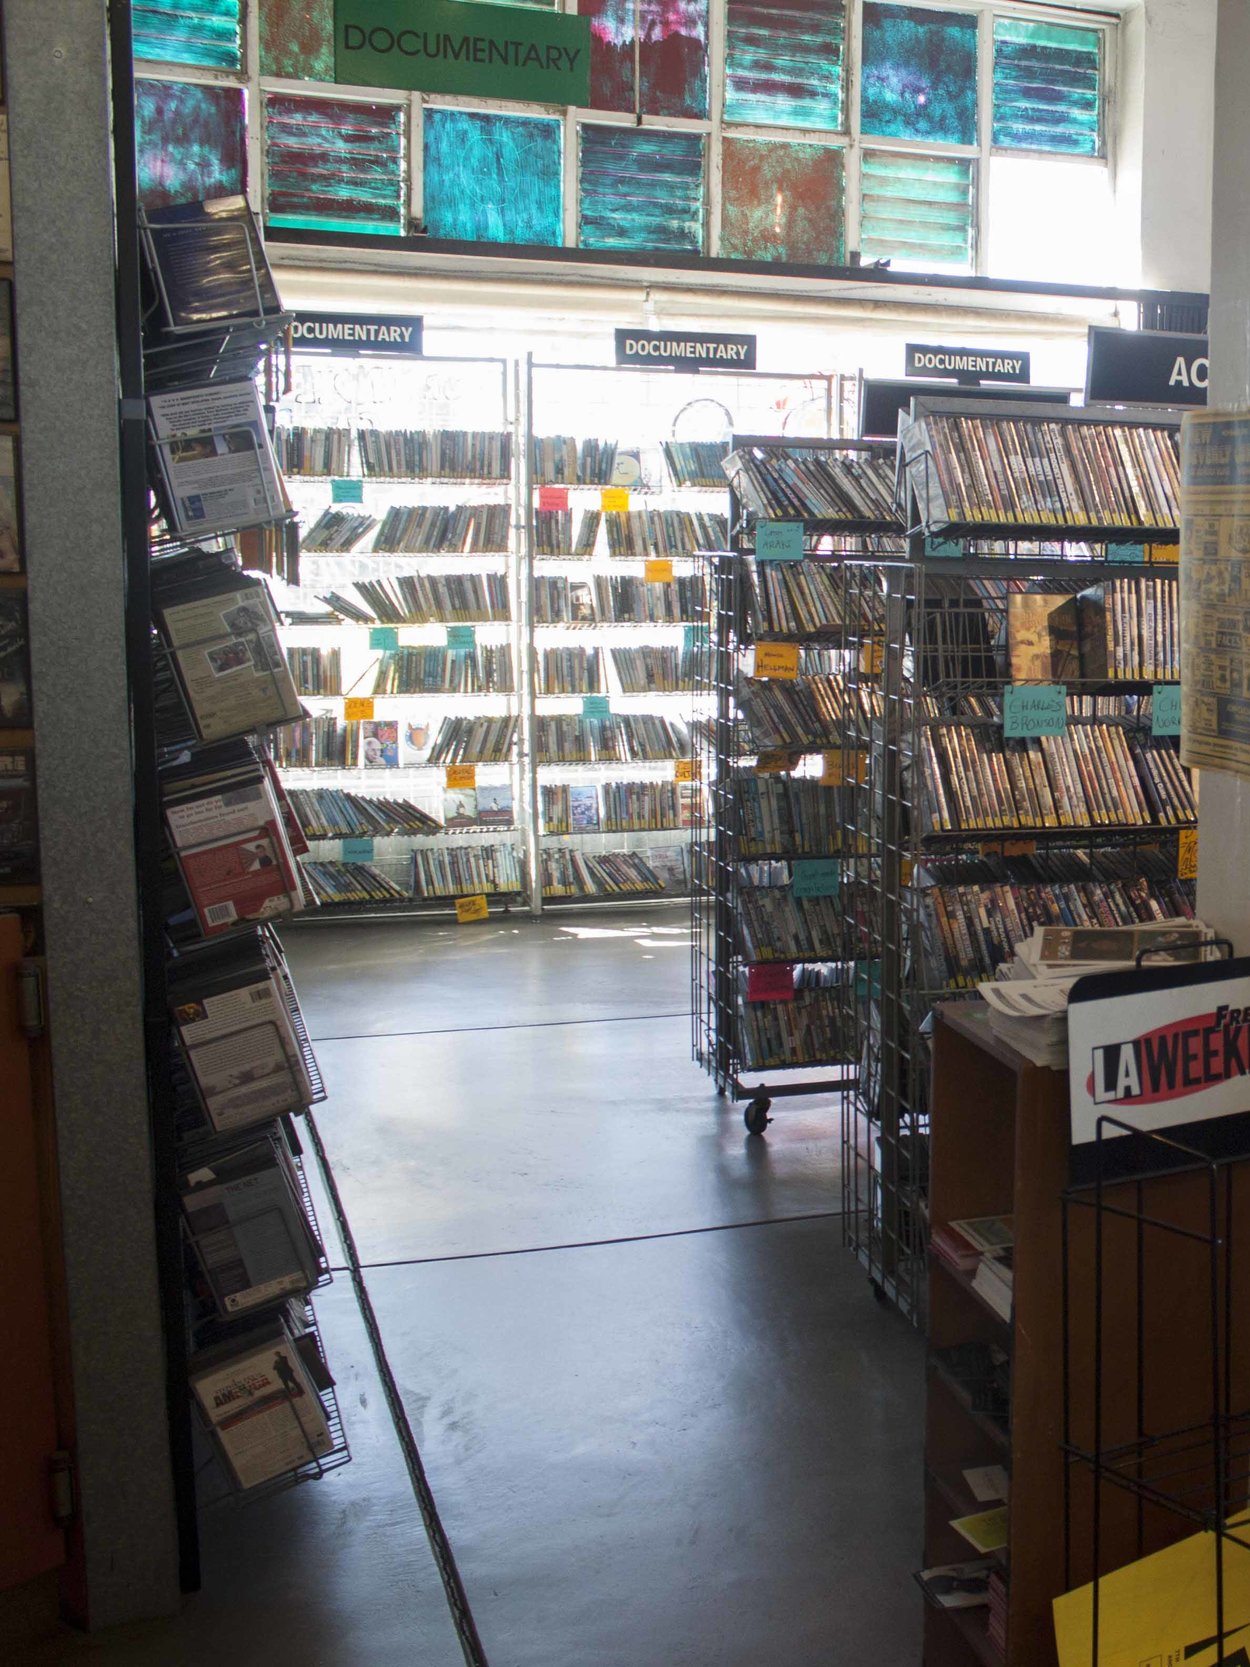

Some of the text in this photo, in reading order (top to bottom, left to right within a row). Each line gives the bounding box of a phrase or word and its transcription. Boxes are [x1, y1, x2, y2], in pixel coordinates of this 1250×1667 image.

[343, 23, 582, 73] DOCUMENTARY
[290, 321, 413, 344] OCUMENTARY
[625, 340, 749, 361] DOCUMENTARY
[914, 352, 1022, 375] DOCUMENTARY
[1008, 697, 1063, 716] CHARLES
[1008, 716, 1066, 733] BRONSON
[1145, 754, 1168, 800] Boarding Gate
[1094, 1042, 1141, 1104] LA
